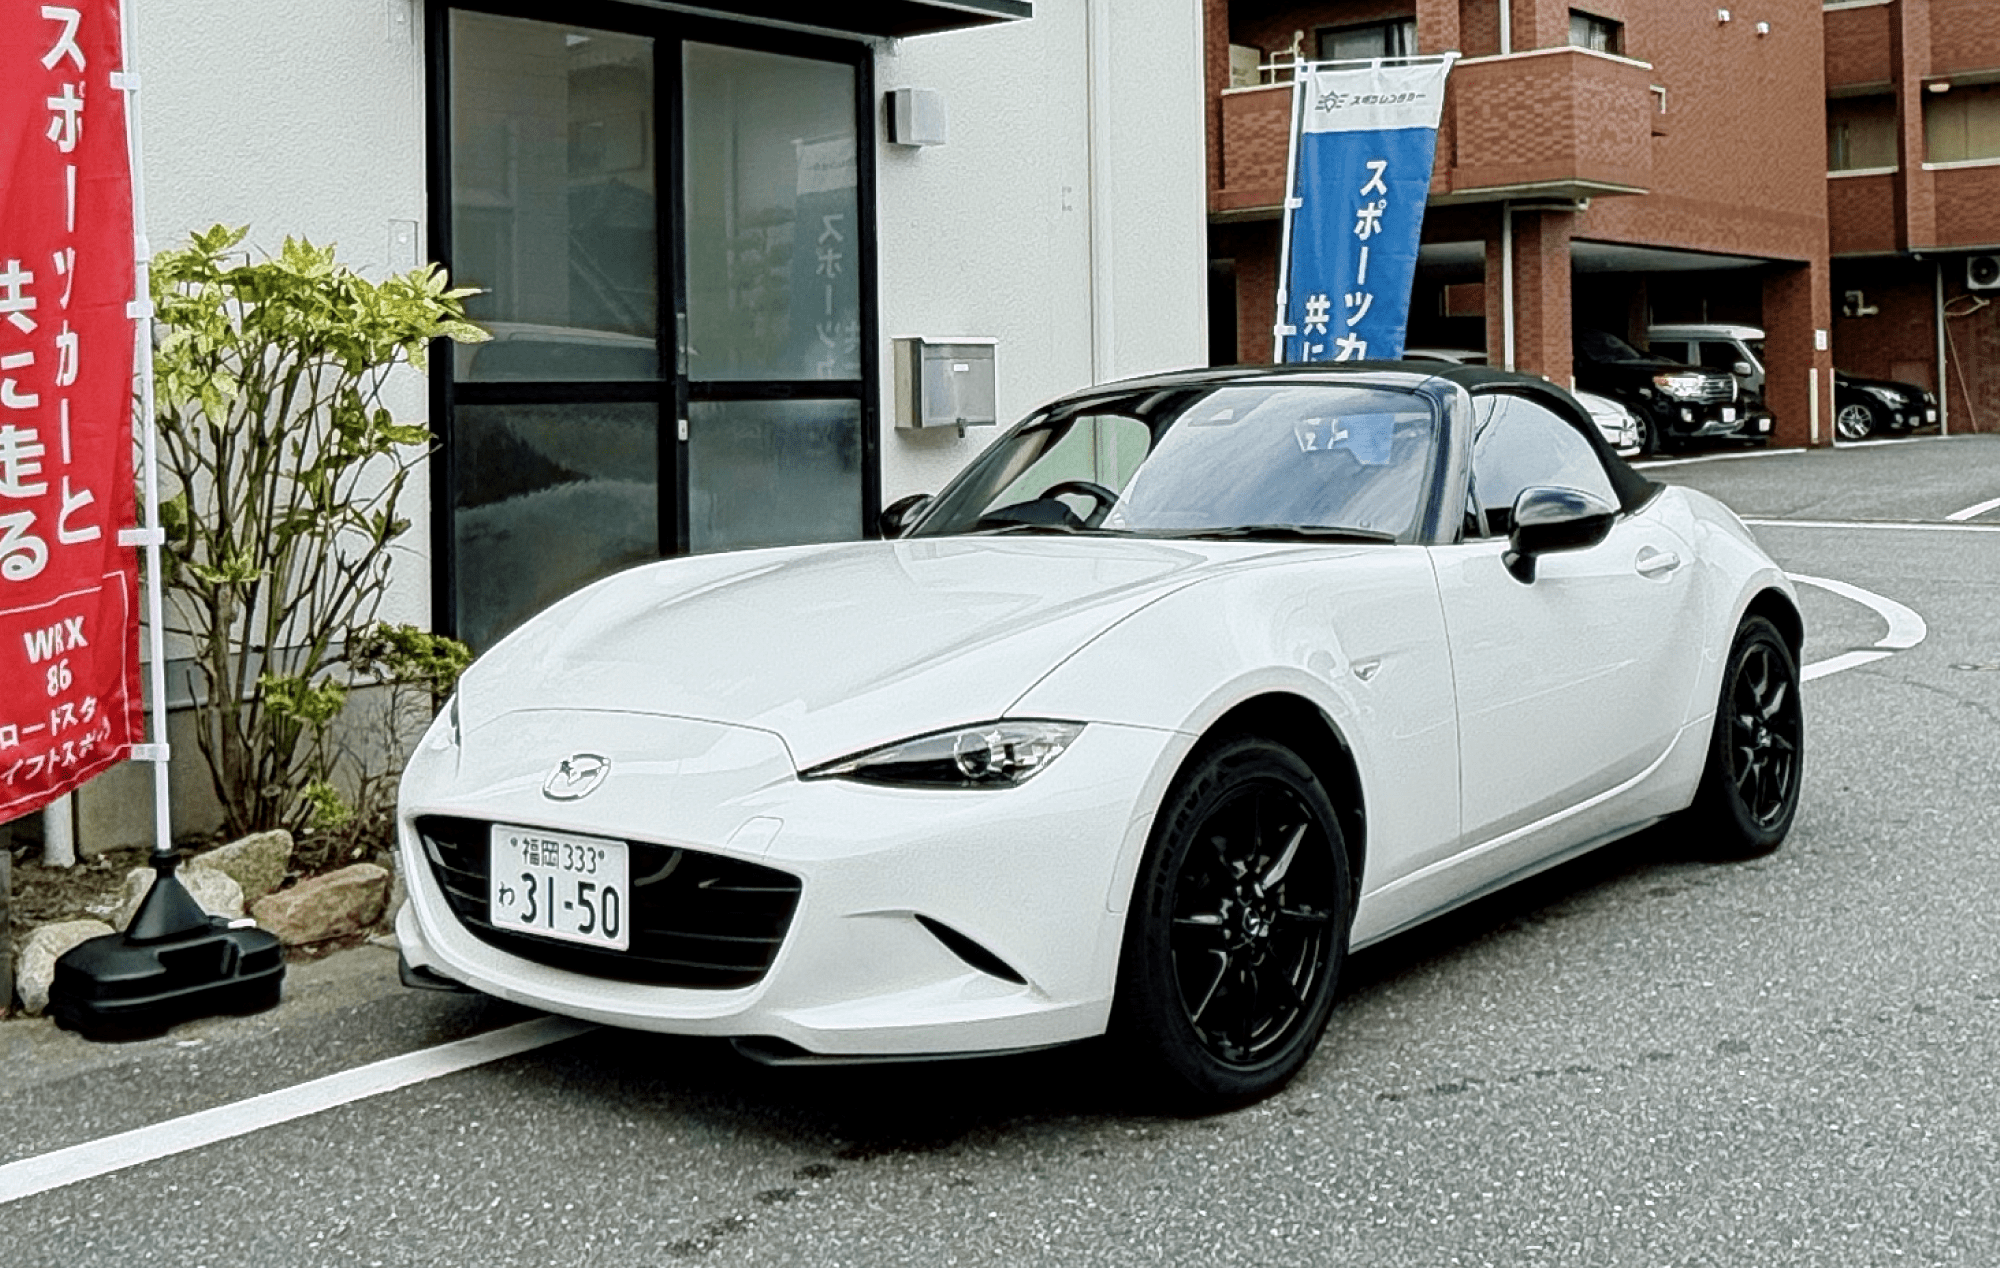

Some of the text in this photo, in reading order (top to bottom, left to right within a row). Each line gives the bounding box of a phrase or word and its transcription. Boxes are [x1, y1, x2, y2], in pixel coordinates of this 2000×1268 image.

[23, 615, 89, 663] WRX
[47, 658, 72, 697] 86
[522, 838, 597, 874] 福岡 333
[499, 872, 620, 939] わ 31-50
